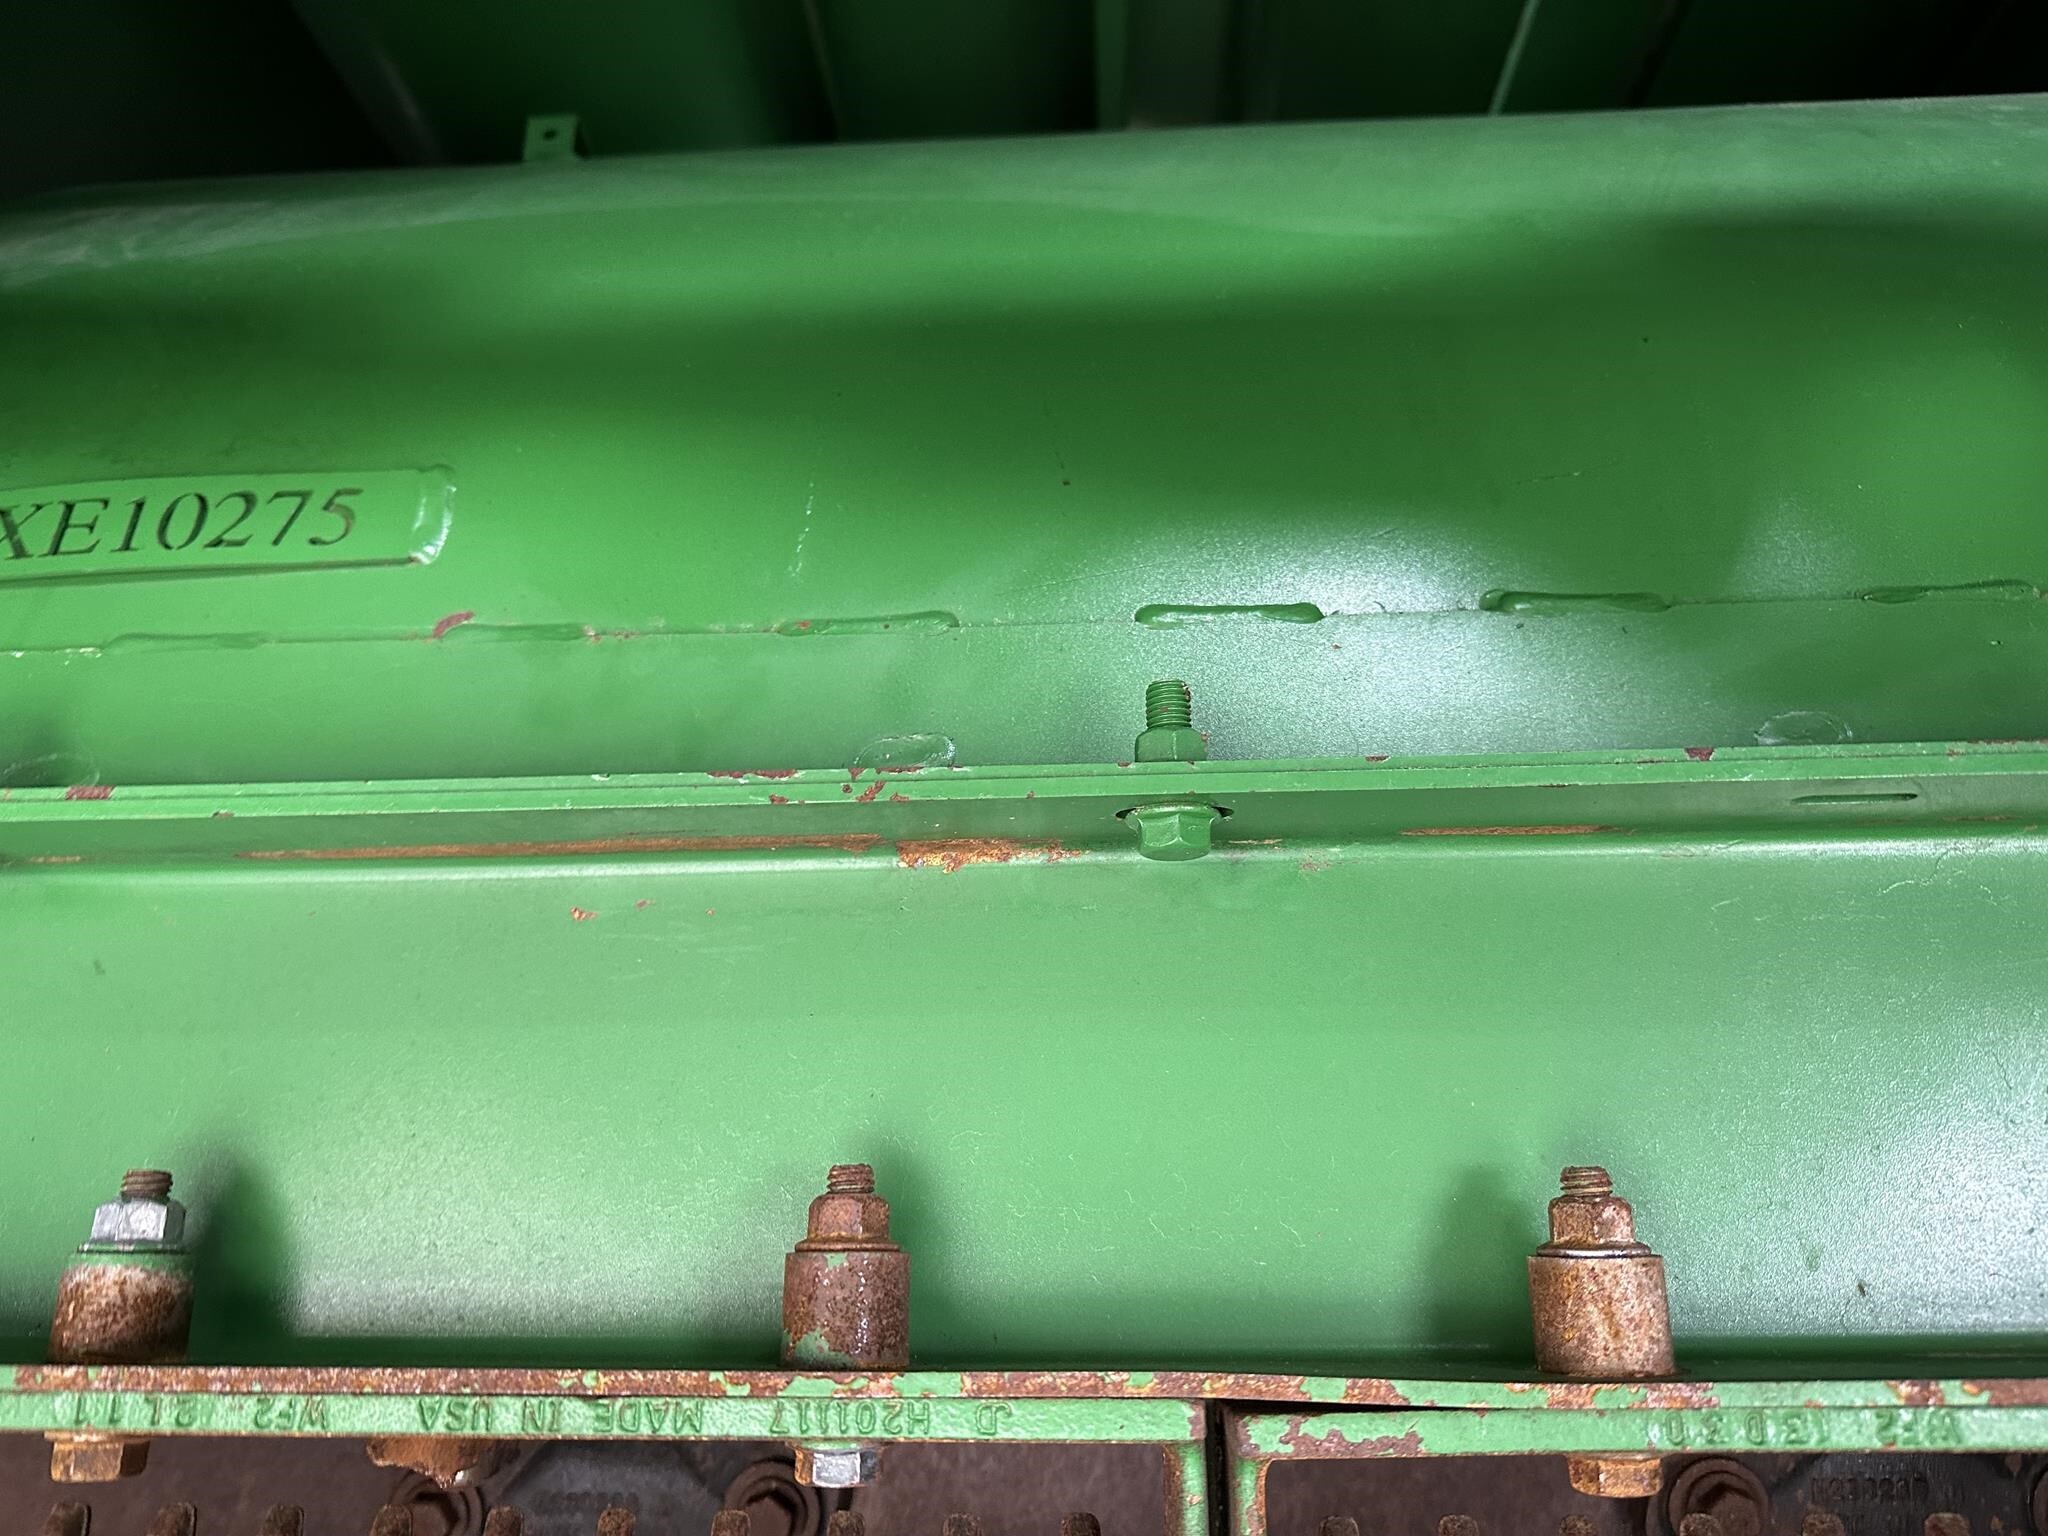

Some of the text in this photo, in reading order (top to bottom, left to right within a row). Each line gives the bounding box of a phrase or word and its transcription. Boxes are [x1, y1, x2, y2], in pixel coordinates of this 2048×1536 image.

[0, 488, 363, 560] XE10275
[419, 1399, 495, 1434] USA
[521, 1400, 563, 1434] IN
[593, 1400, 703, 1435] MADE
[769, 1400, 930, 1436] H201117
